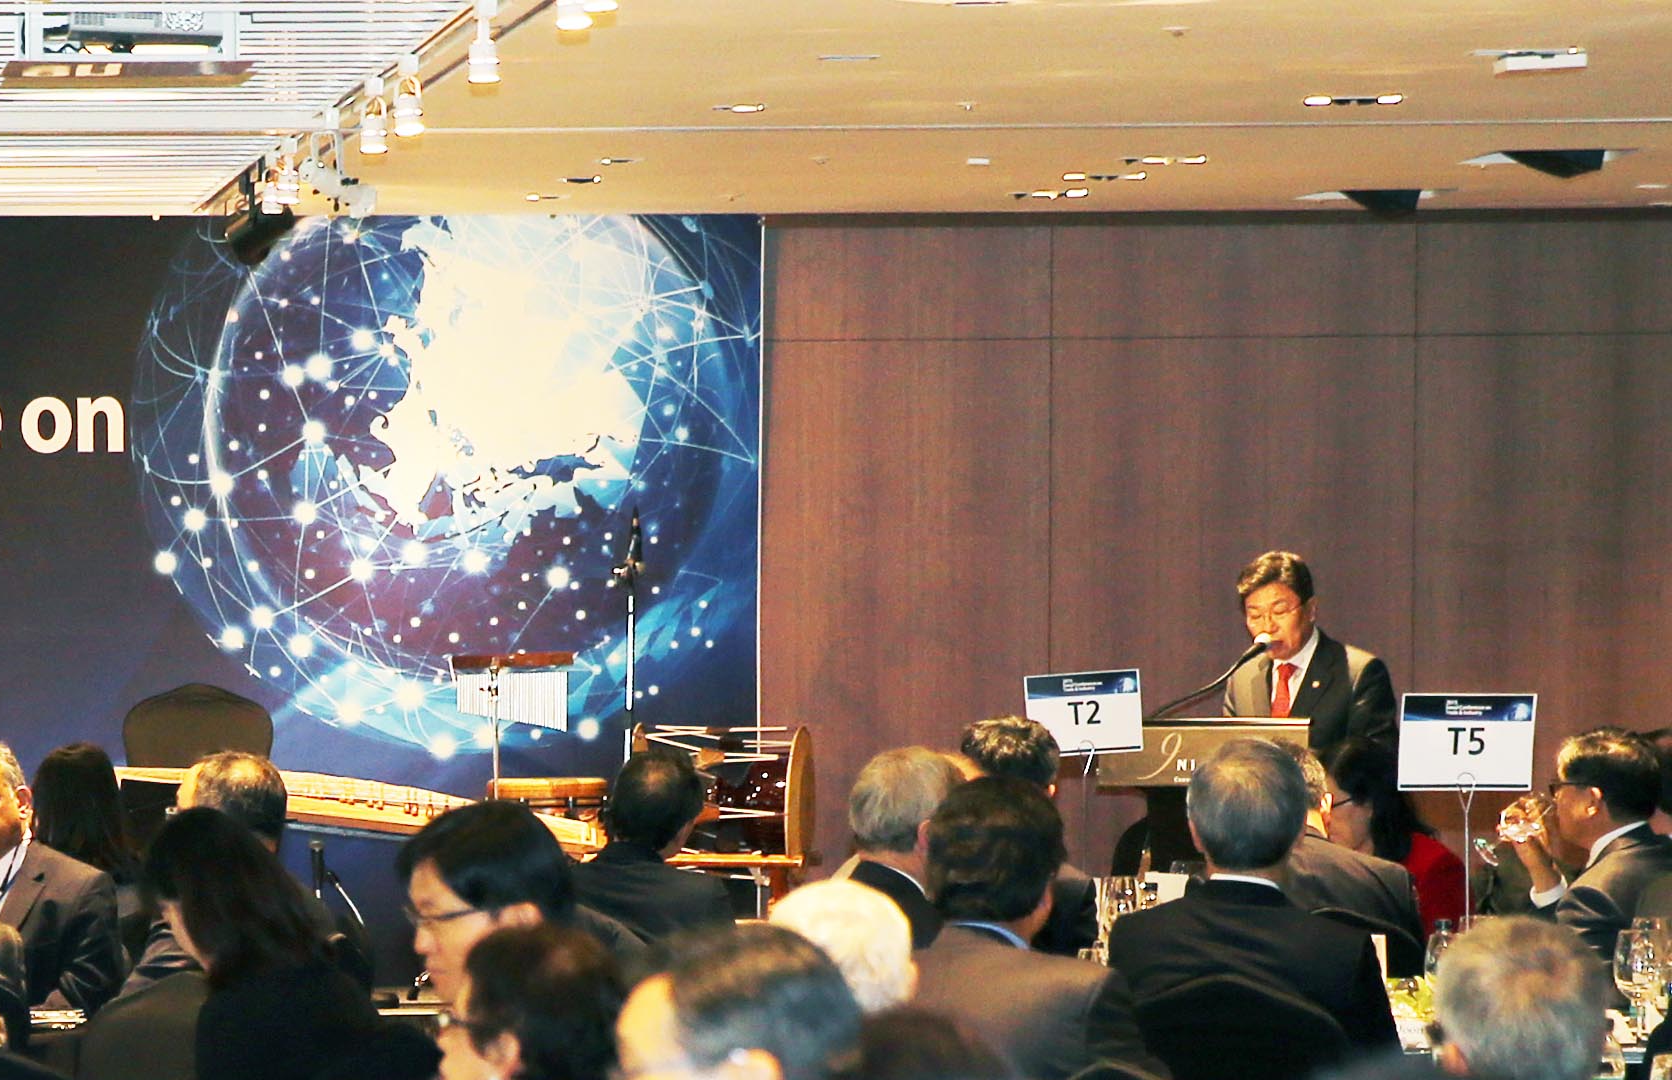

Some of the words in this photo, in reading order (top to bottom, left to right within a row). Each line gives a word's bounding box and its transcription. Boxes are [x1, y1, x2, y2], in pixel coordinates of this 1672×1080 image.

[21, 396, 125, 454] on
[1067, 700, 1102, 725] T2
[1447, 727, 1485, 755] T5
